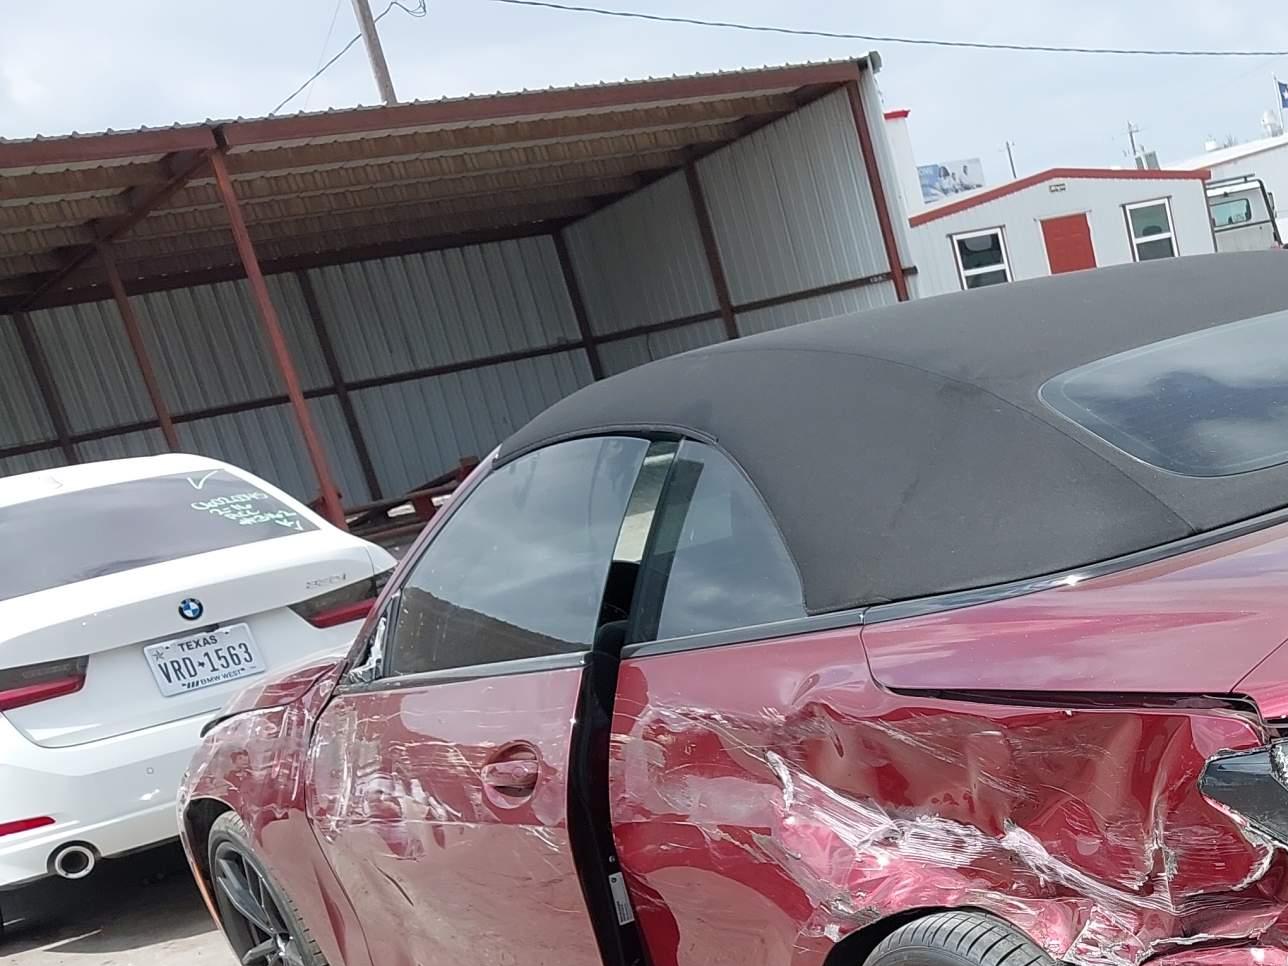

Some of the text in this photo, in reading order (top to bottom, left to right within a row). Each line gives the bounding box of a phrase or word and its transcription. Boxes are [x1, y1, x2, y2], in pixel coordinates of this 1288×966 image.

[178, 635, 218, 652] TEXAS
[200, 669, 241, 685] BMW WEST
